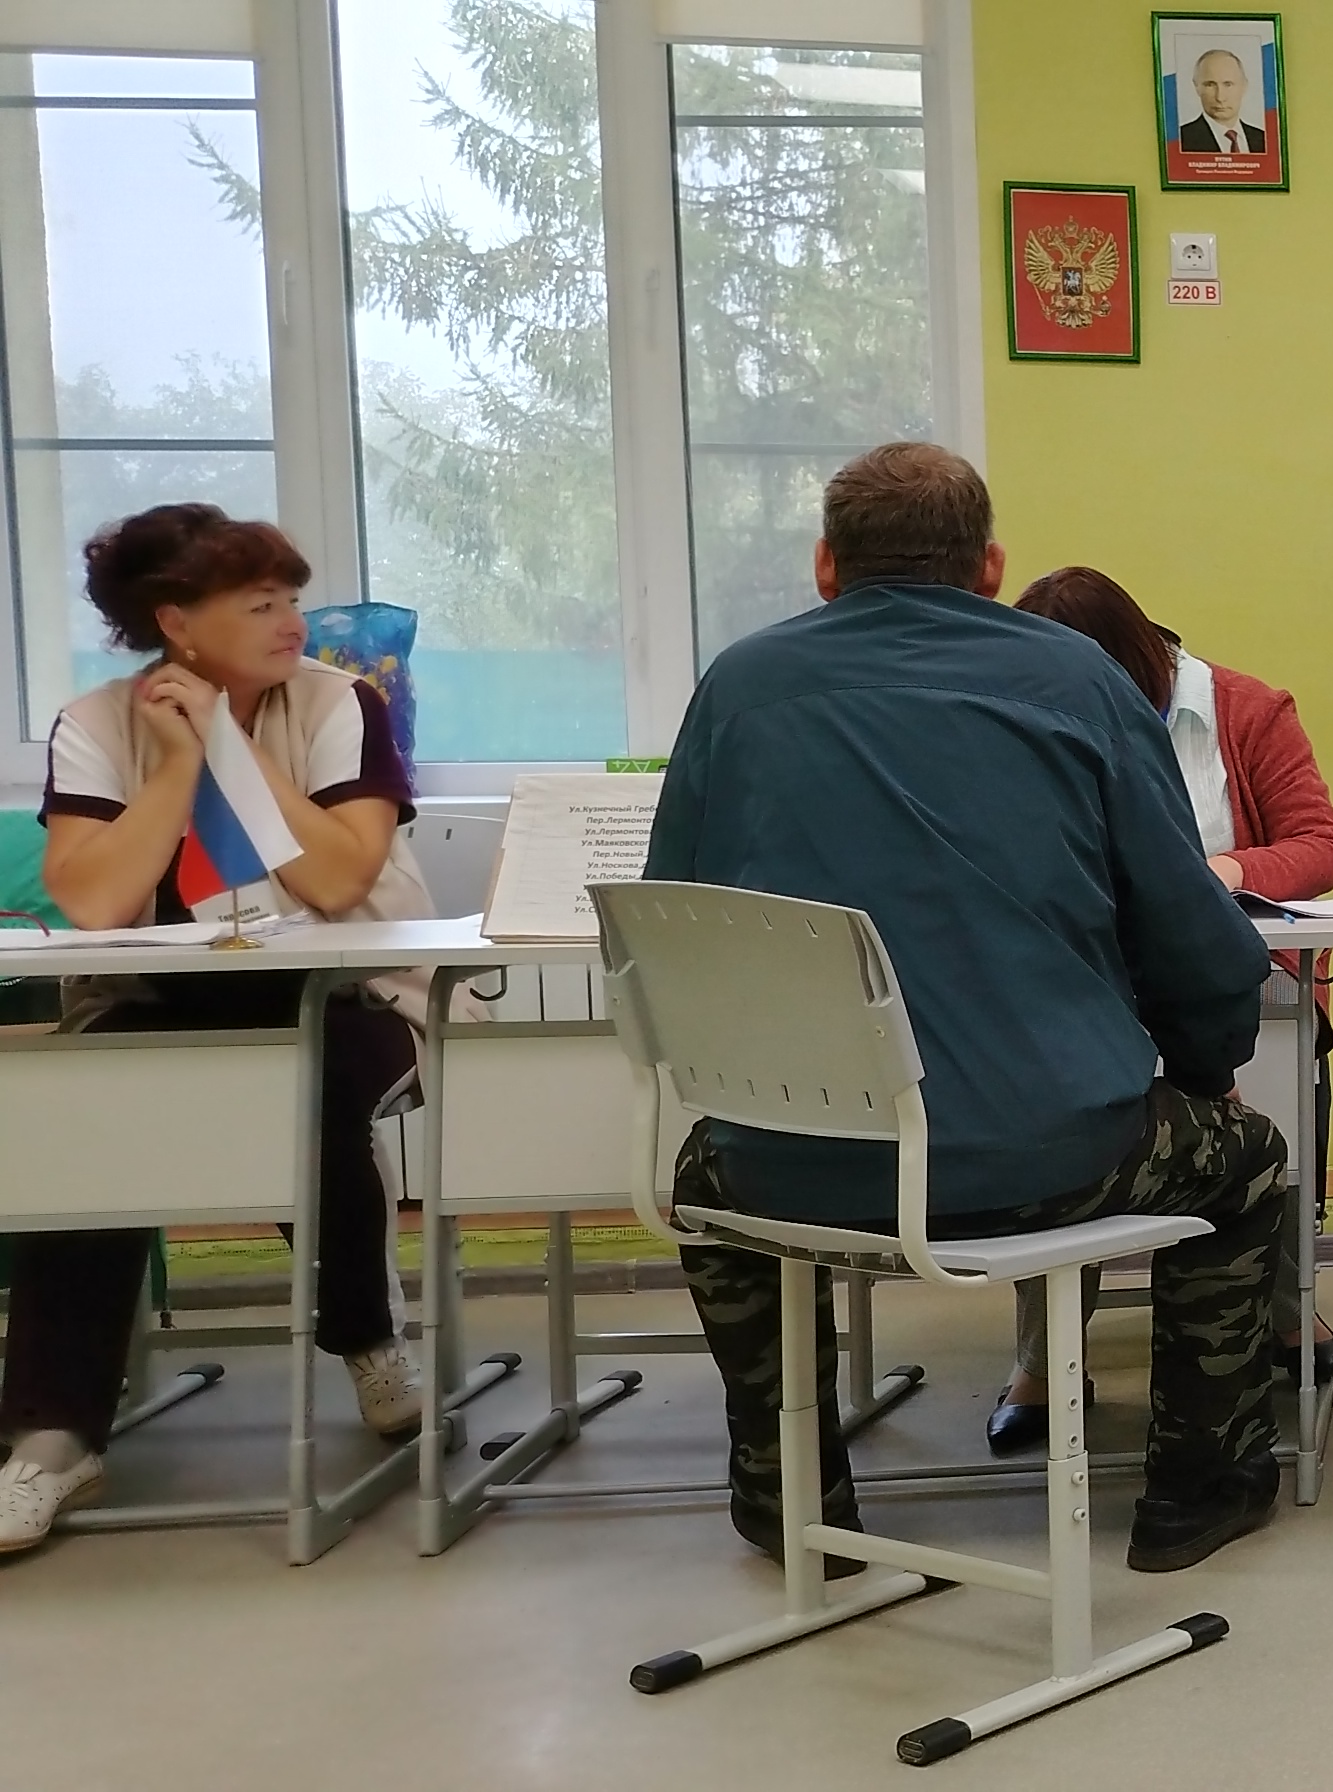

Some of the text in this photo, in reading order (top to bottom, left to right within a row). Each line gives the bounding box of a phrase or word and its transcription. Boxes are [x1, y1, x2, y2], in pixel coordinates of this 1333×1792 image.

[1172, 285, 1217, 300] 220 В
[633, 804, 657, 814] Греб
[586, 816, 653, 826] Пер.Лермонто
[584, 827, 651, 837] Ул.Лермонтов
[581, 839, 649, 848] Ул.Маяковског
[217, 905, 261, 922] Тарсова
[574, 906, 596, 914] Ул.С
